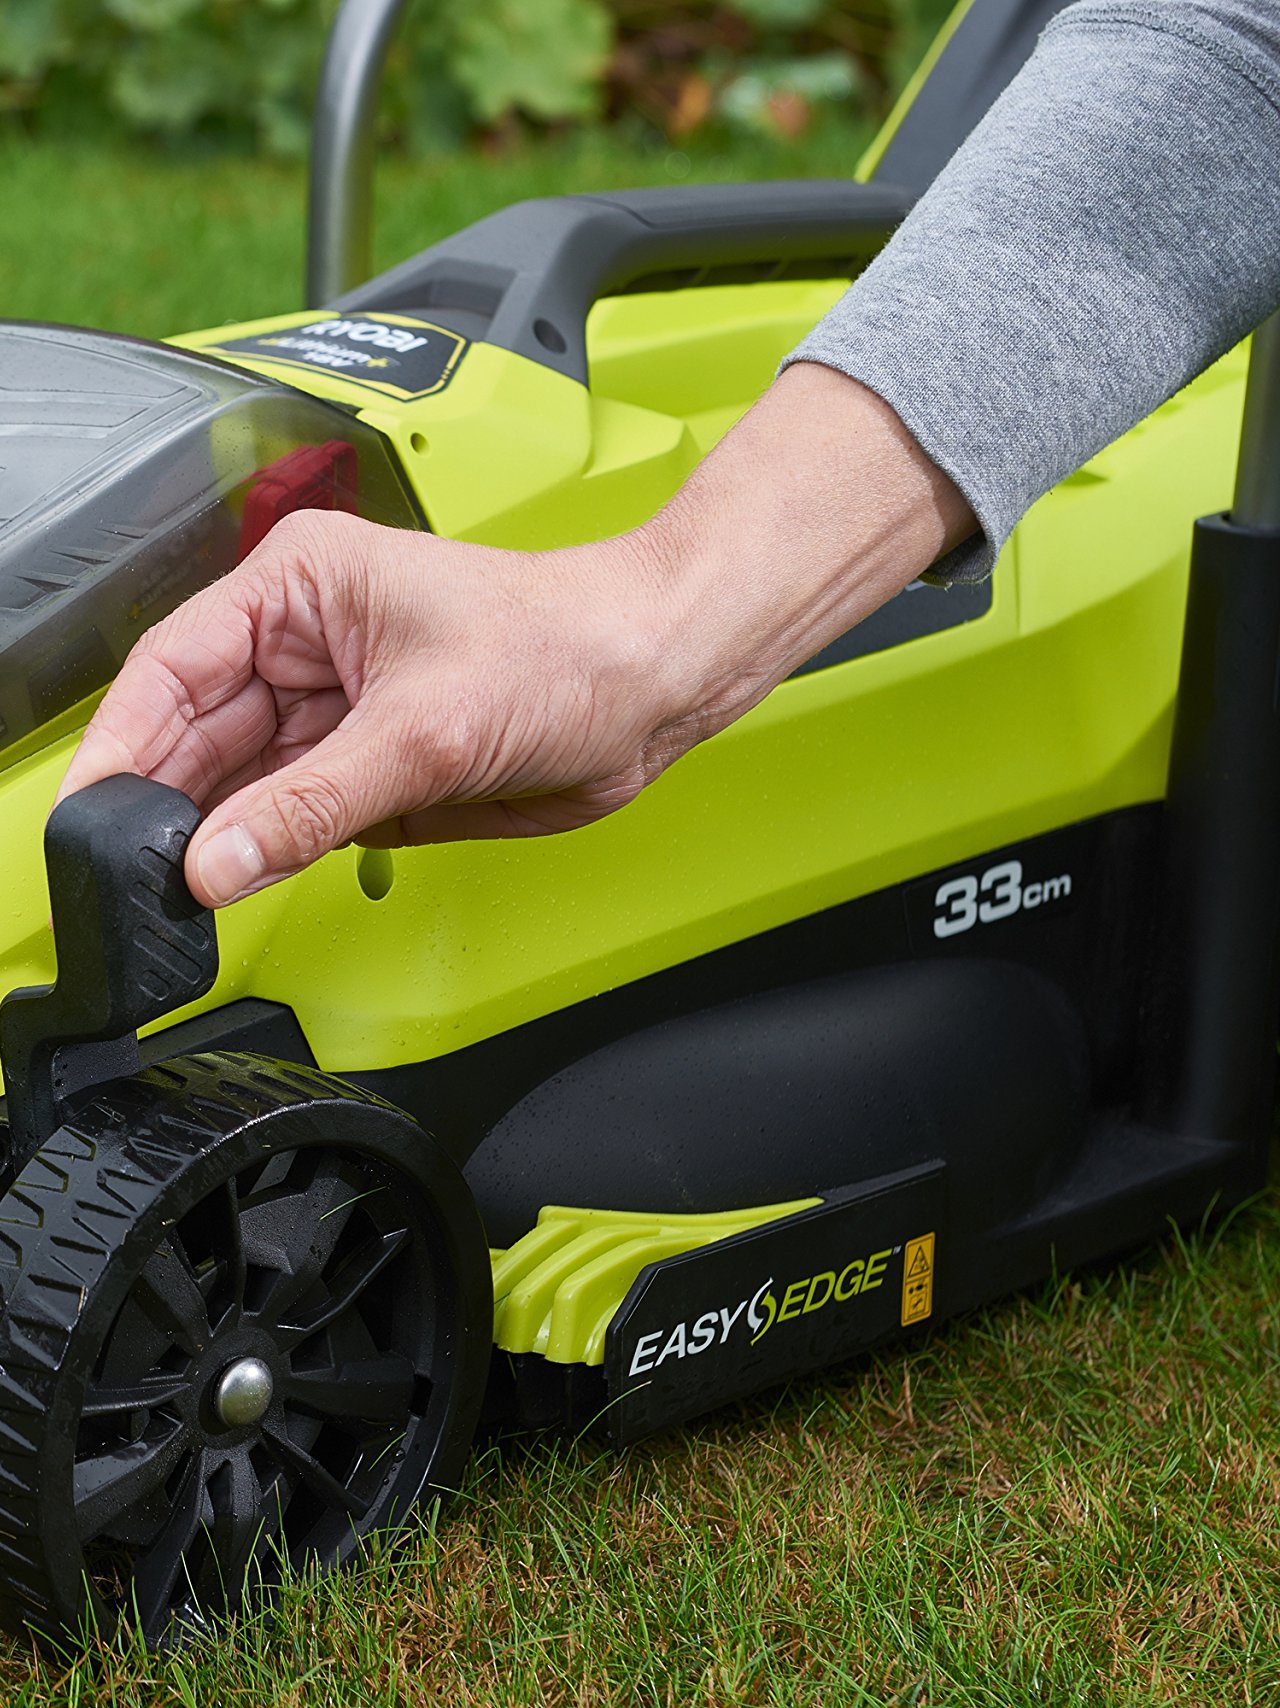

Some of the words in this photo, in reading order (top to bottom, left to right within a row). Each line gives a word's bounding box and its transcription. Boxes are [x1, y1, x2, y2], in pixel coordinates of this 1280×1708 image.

[302, 319, 428, 353] RYOBI
[933, 860, 1072, 939] 33cm
[628, 1300, 748, 1377] EASY
[776, 1249, 893, 1323] EDGE
